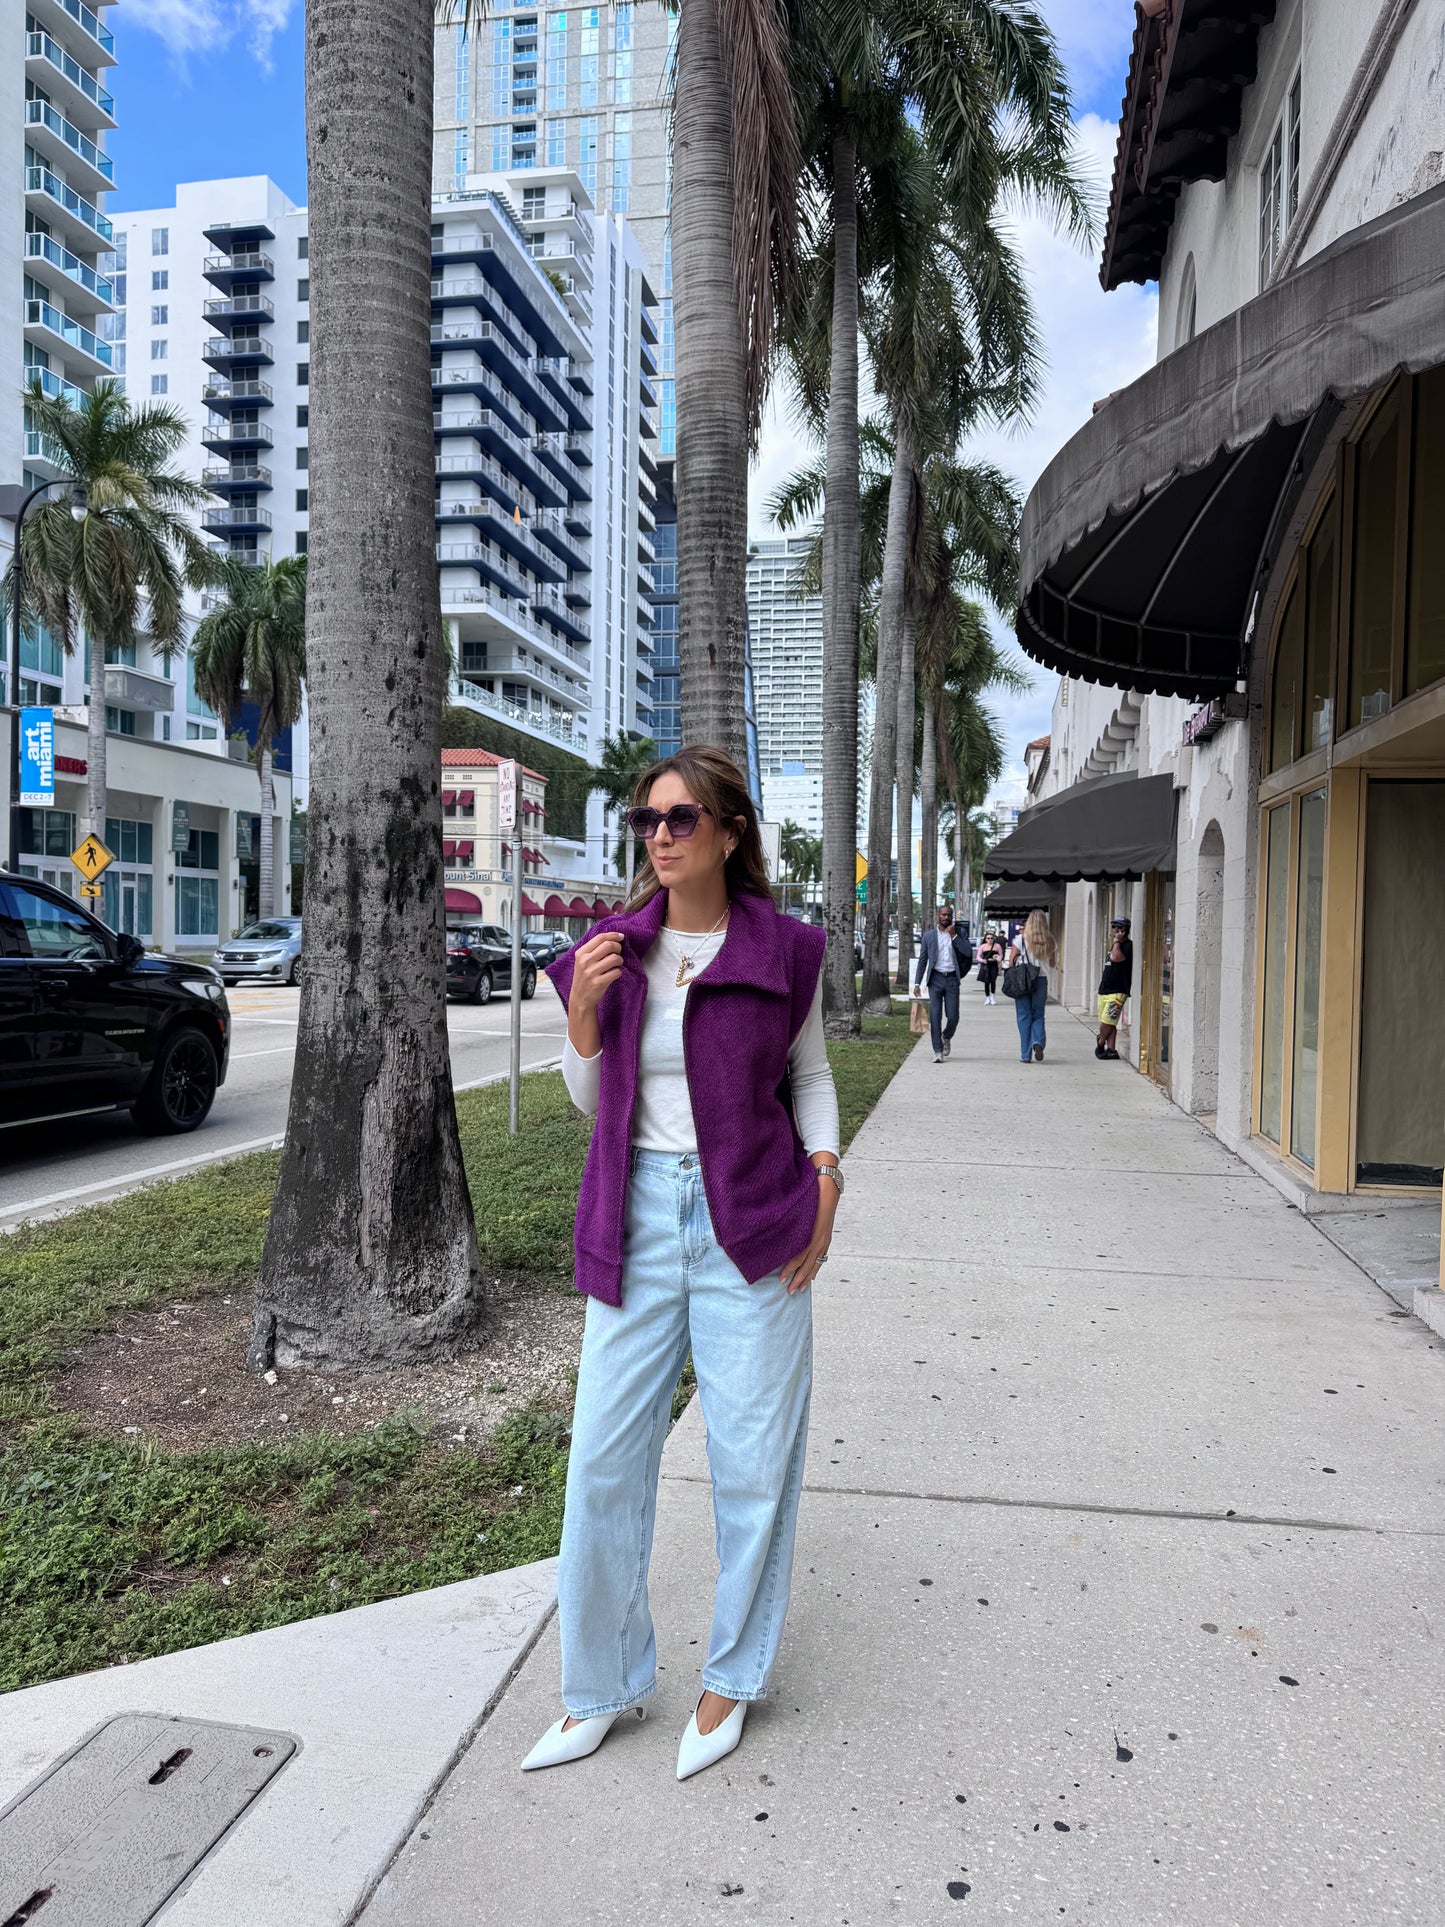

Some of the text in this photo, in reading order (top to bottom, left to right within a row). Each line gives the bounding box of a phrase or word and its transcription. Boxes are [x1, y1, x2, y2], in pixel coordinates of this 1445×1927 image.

[25, 728, 39, 760] art
[36, 722, 52, 786] miami
[444, 871, 467, 881] ount
[469, 871, 493, 881] Sinai
